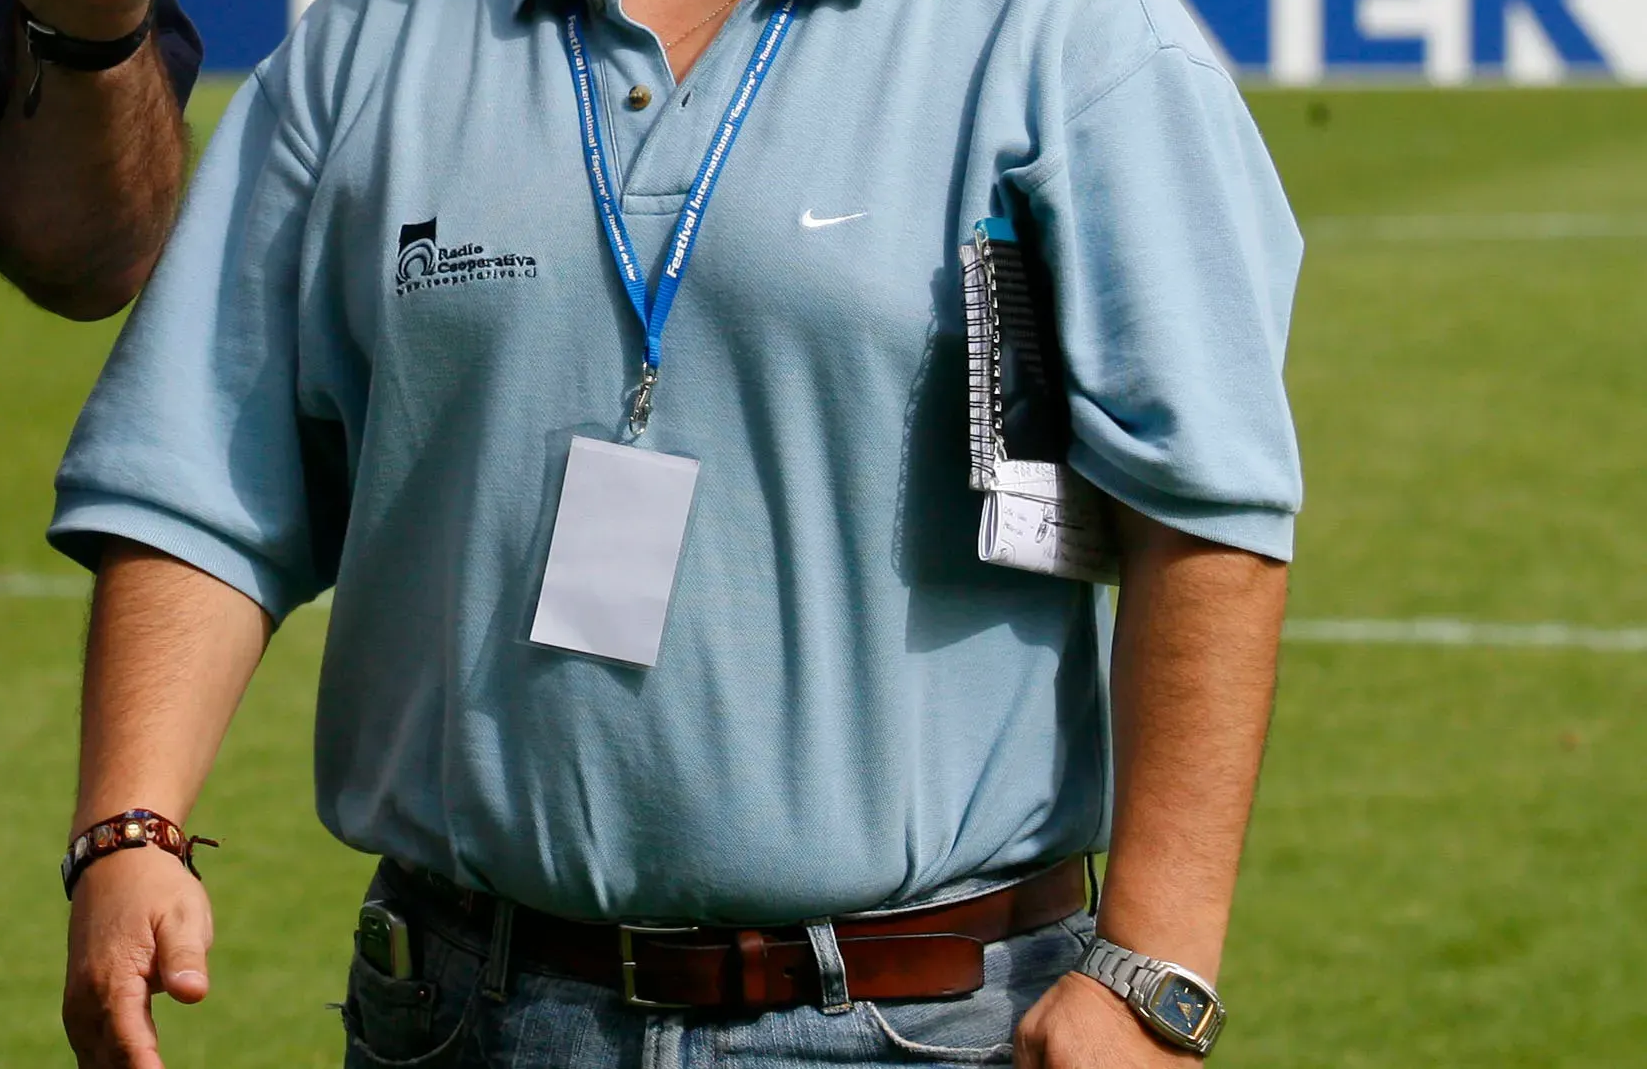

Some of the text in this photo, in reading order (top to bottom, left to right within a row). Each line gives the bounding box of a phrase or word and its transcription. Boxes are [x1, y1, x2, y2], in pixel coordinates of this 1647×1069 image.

[568, 15, 587, 71] Festival
[579, 73, 598, 147] International
[667, 210, 696, 278] Festival
[690, 123, 733, 209] International
[759, 30, 779, 61] Toulon
[437, 254, 536, 273] Cooperativa
[438, 243, 483, 260] Radio
